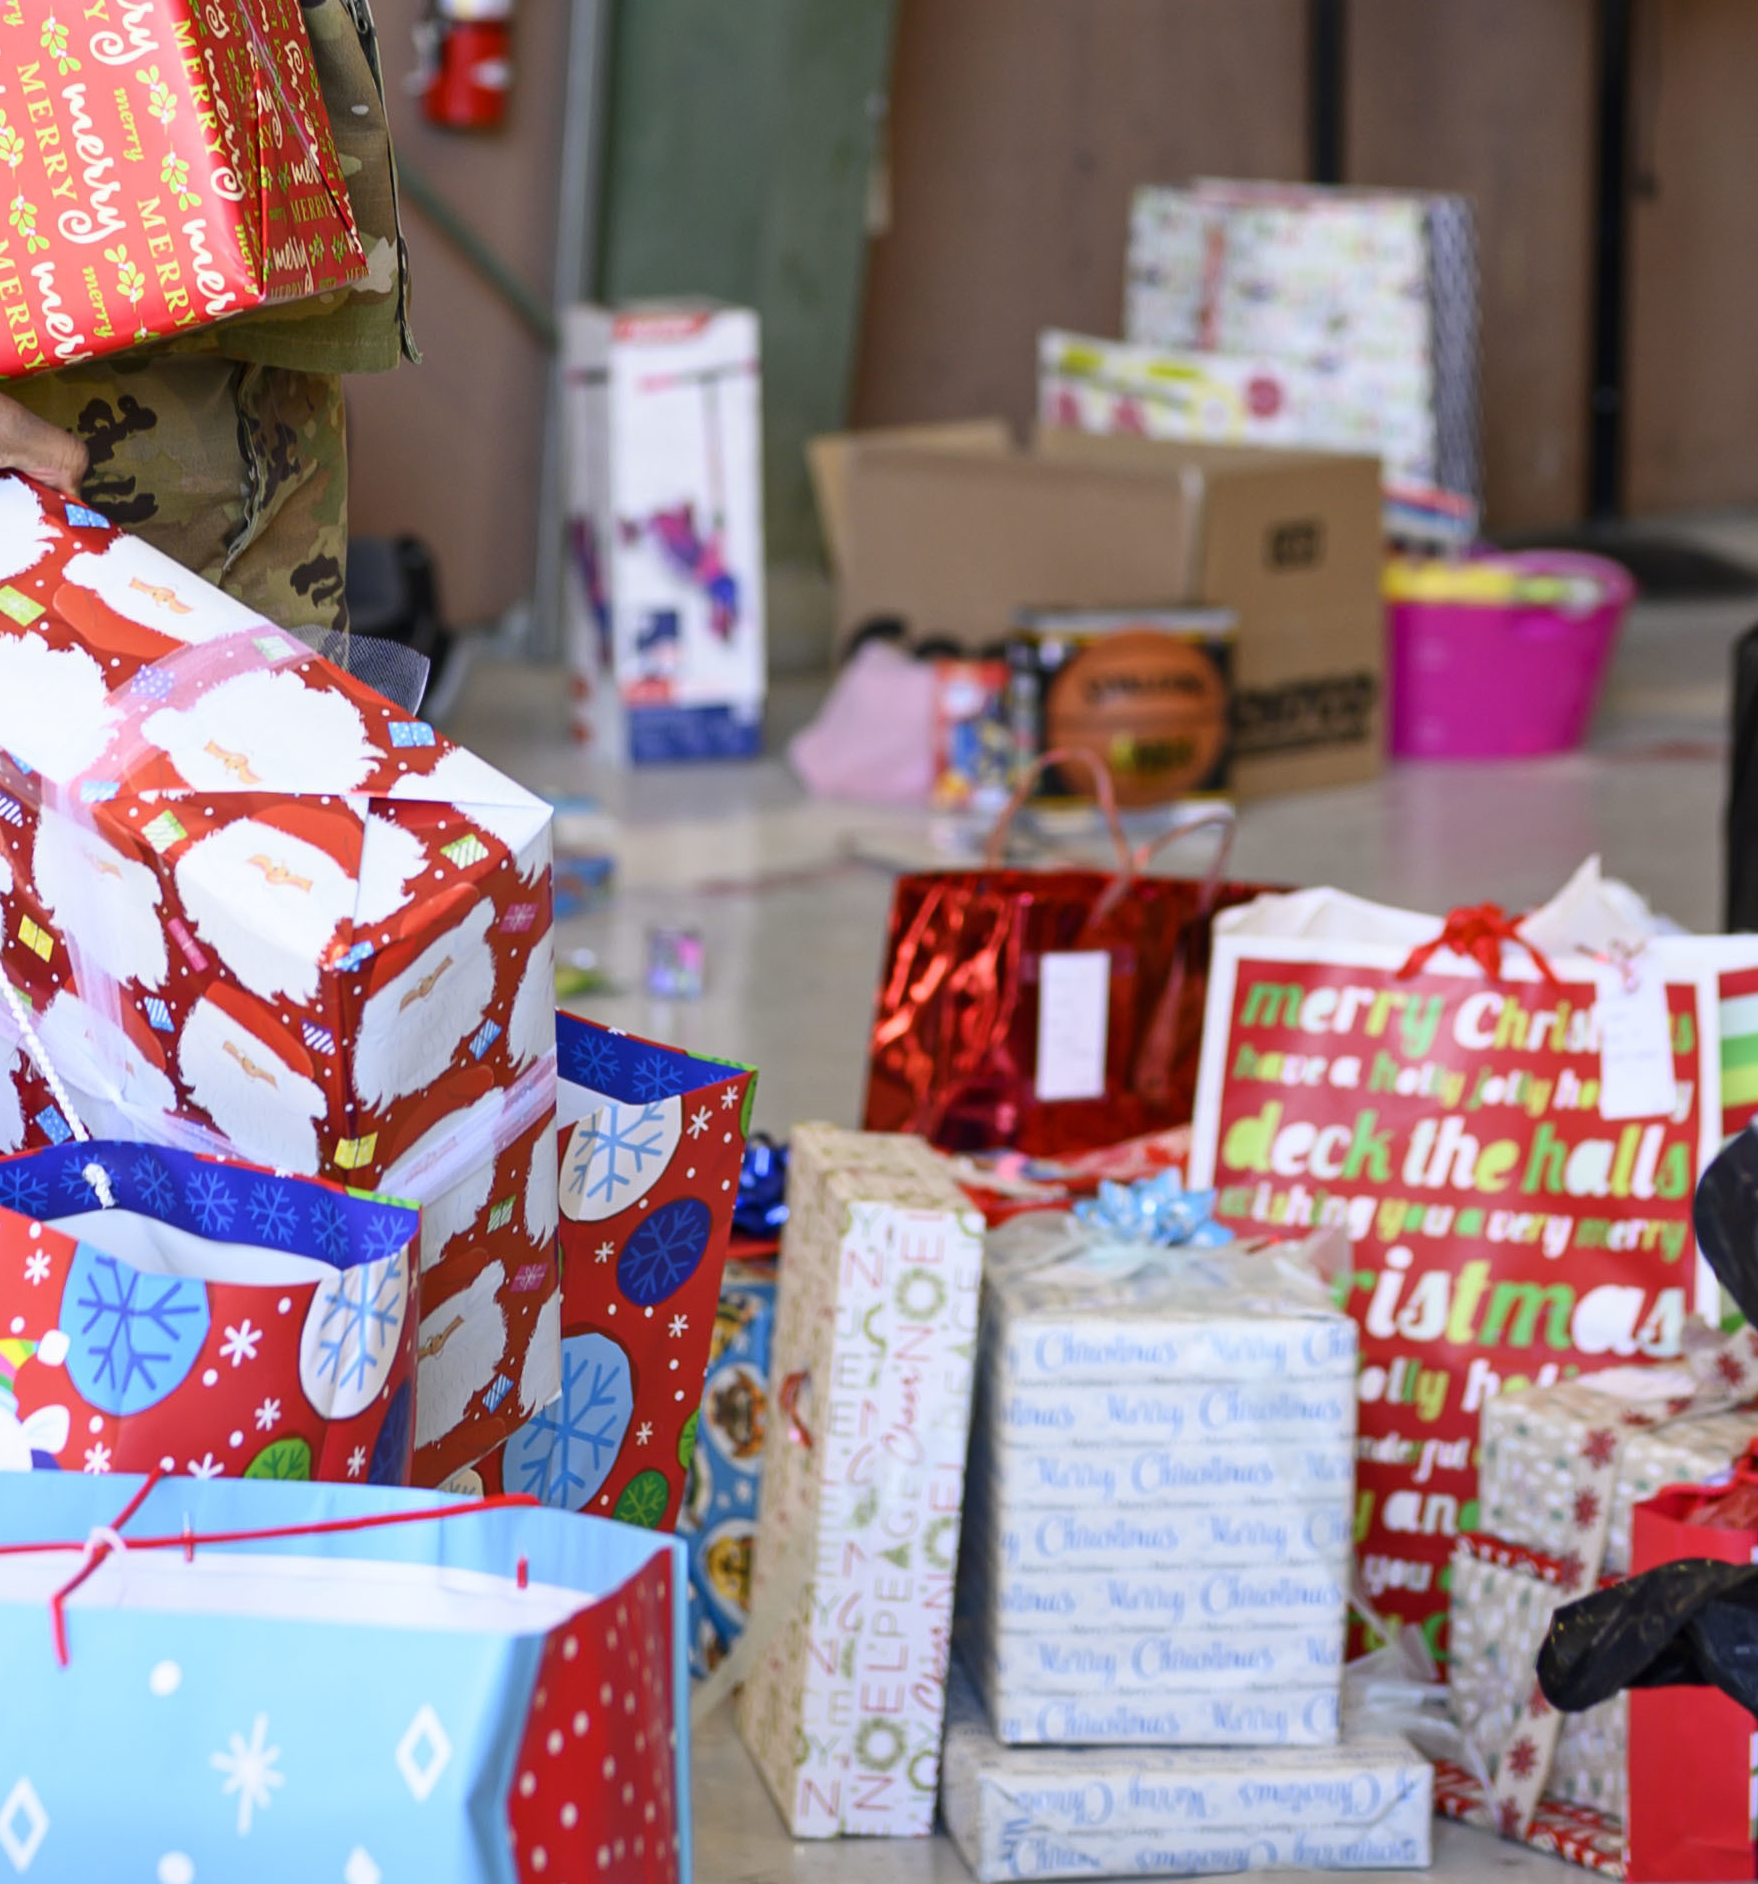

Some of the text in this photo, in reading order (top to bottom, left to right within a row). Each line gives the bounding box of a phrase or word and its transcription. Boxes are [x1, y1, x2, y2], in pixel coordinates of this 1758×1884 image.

[113, 87, 145, 163] merry
[172, 19, 226, 158] MERRY
[17, 61, 79, 202] MERRY
[57, 83, 127, 245] merry
[138, 195, 201, 328] MERRY
[82, 266, 115, 339] merry
[1242, 980, 1442, 1059] merry
[1234, 1045, 1327, 1086] have
[1329, 1056, 1362, 1089] a
[1369, 1053, 1465, 1109] holly
[1467, 1068, 1551, 1117] jolly
[1224, 1100, 1691, 1199] deck the halls
[1377, 1197, 1455, 1243] you
[1454, 1206, 1486, 1236] a
[1486, 1207, 1574, 1259] very
[1574, 1218, 1687, 1263] merry
[1357, 1357, 1449, 1422] olly
